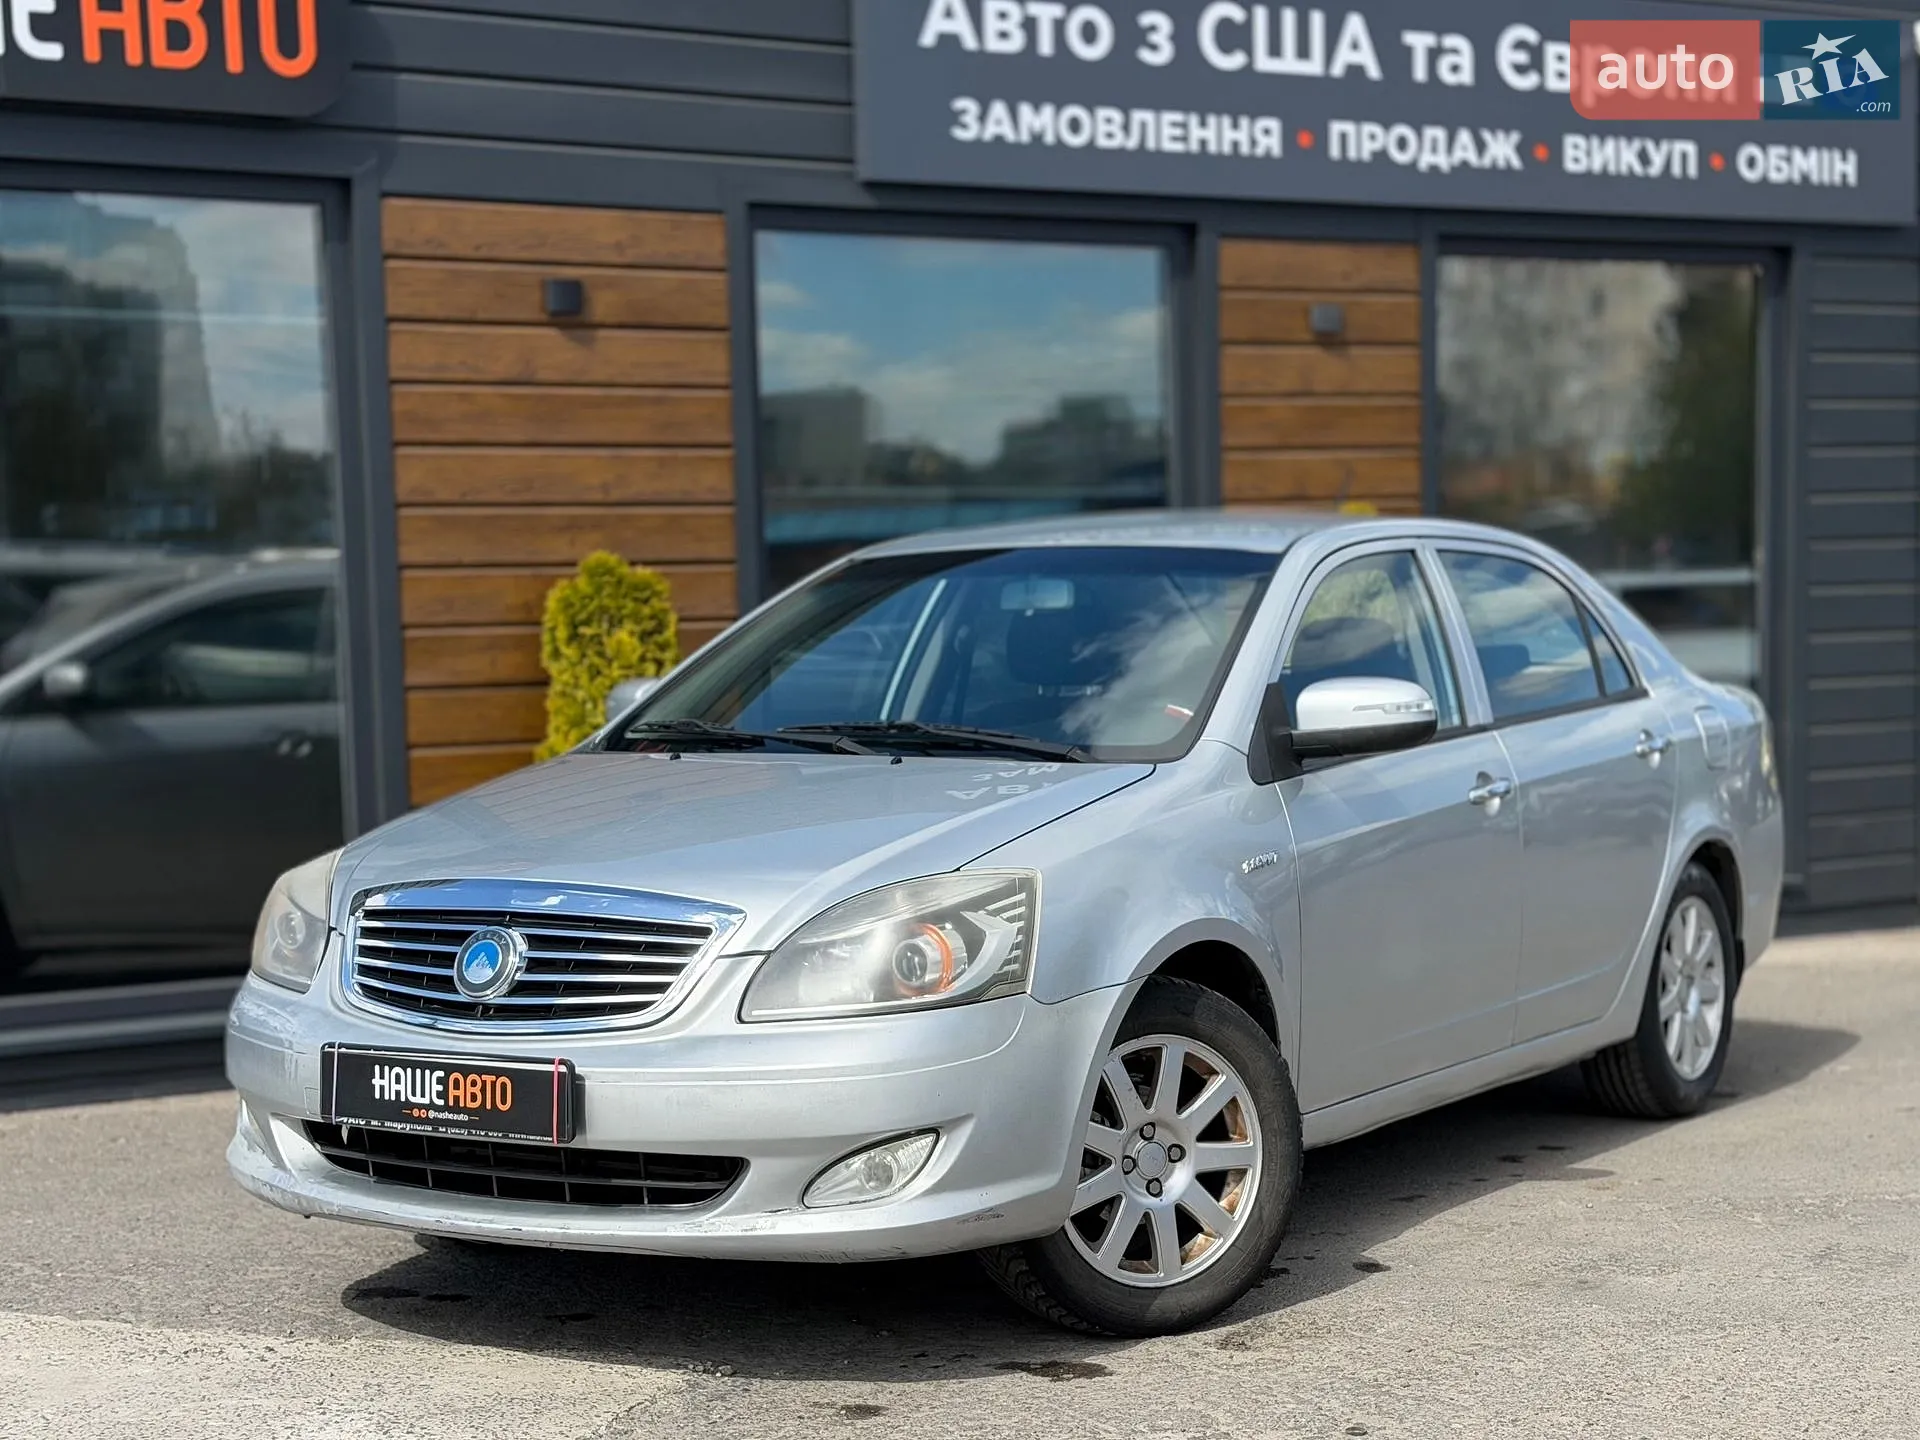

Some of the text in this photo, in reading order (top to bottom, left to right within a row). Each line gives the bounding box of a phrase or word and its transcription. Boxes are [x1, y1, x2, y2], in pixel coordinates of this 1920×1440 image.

[917, 0, 1115, 62] Авто
[1136, 9, 1176, 67] з
[1198, 0, 1384, 81] США
[1402, 29, 1476, 87] та
[949, 96, 1860, 188] ЗАМОВЛЕННЯ ПРОДАЖ ВИКУП ОБМІН
[372, 1064, 513, 1112] НАШЕ АВТО
[427, 1109, 470, 1122] @nasheauto
